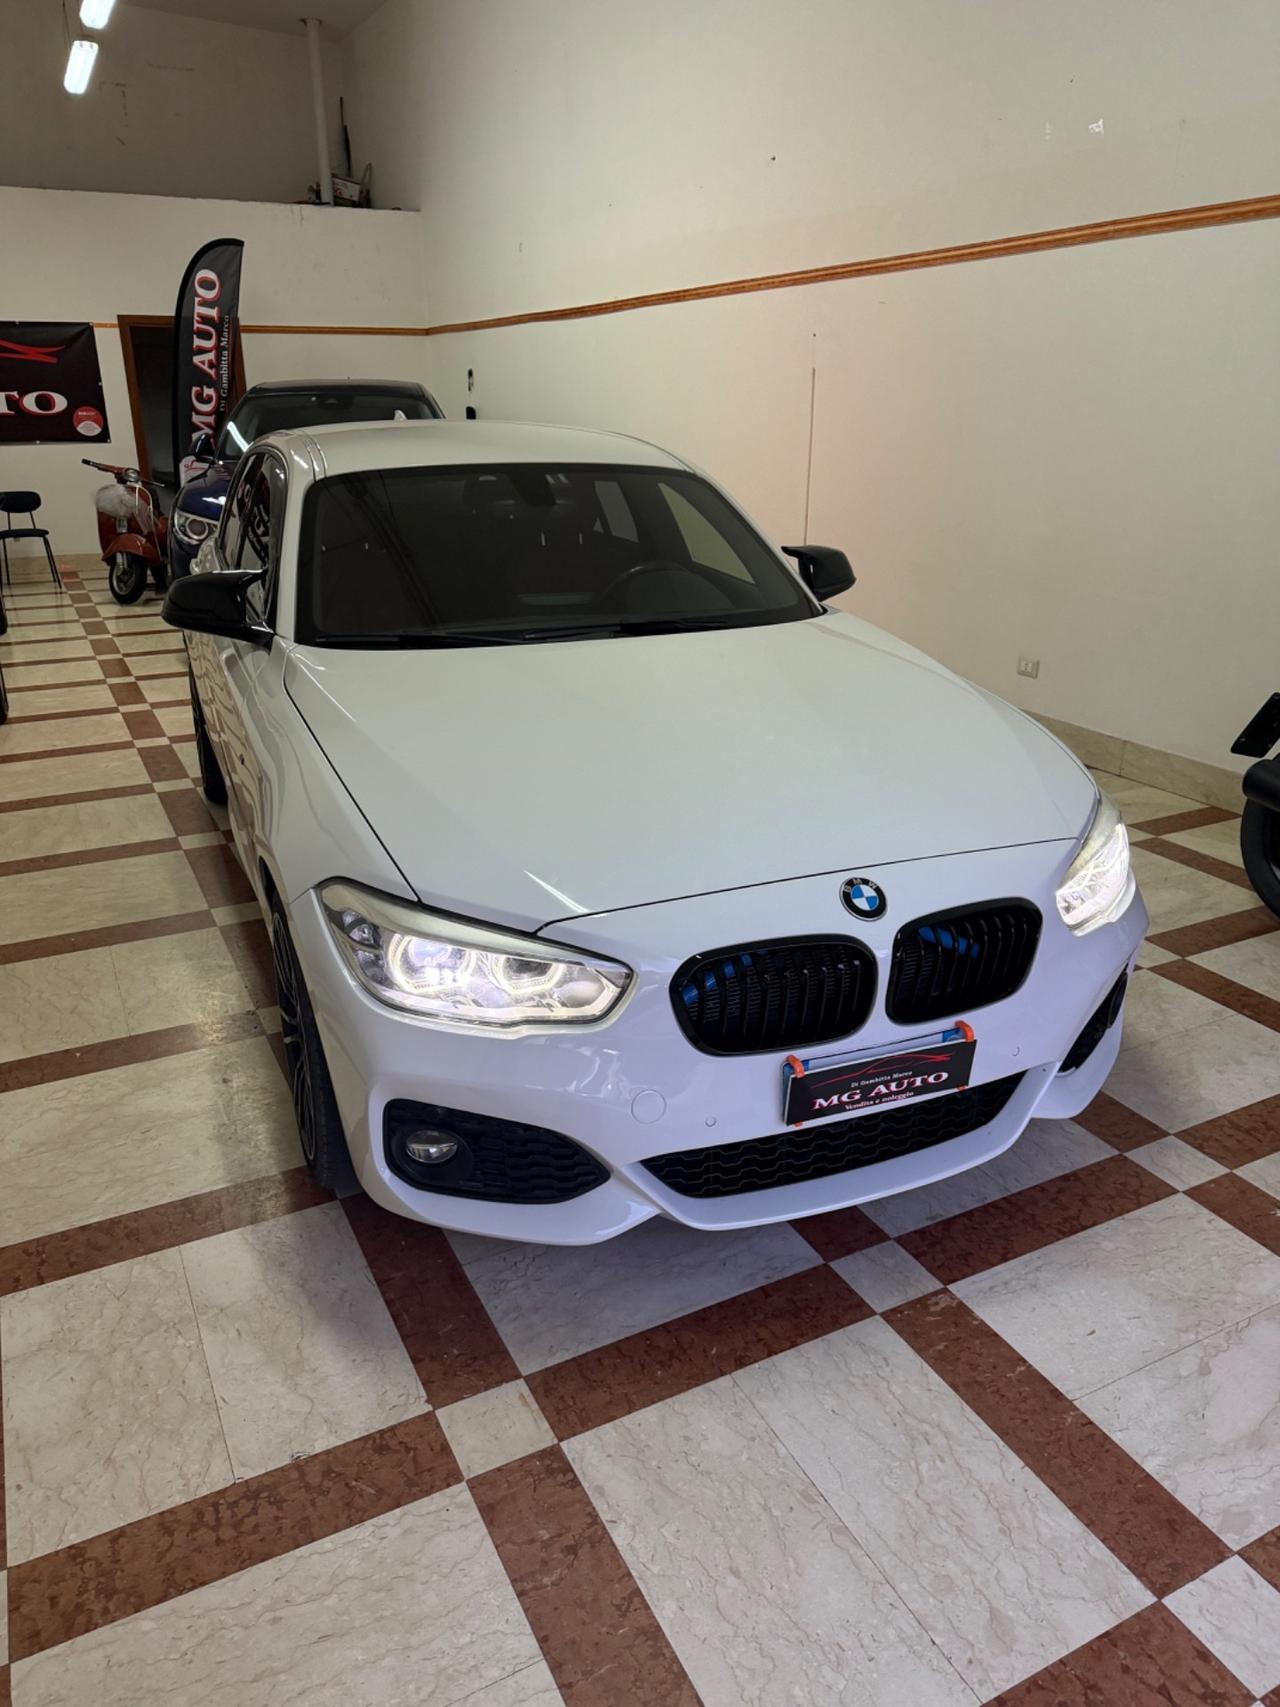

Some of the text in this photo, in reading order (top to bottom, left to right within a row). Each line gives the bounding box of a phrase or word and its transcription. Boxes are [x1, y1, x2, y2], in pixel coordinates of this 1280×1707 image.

[192, 268, 221, 381] AUTO
[220, 315, 230, 348] Marco
[220, 350, 229, 397] Gambitta
[843, 878, 878, 892] BMW
[812, 1071, 949, 1110] MG AUTO
[845, 1099, 874, 1110] Vendita
[881, 1091, 914, 1104] noleggio
